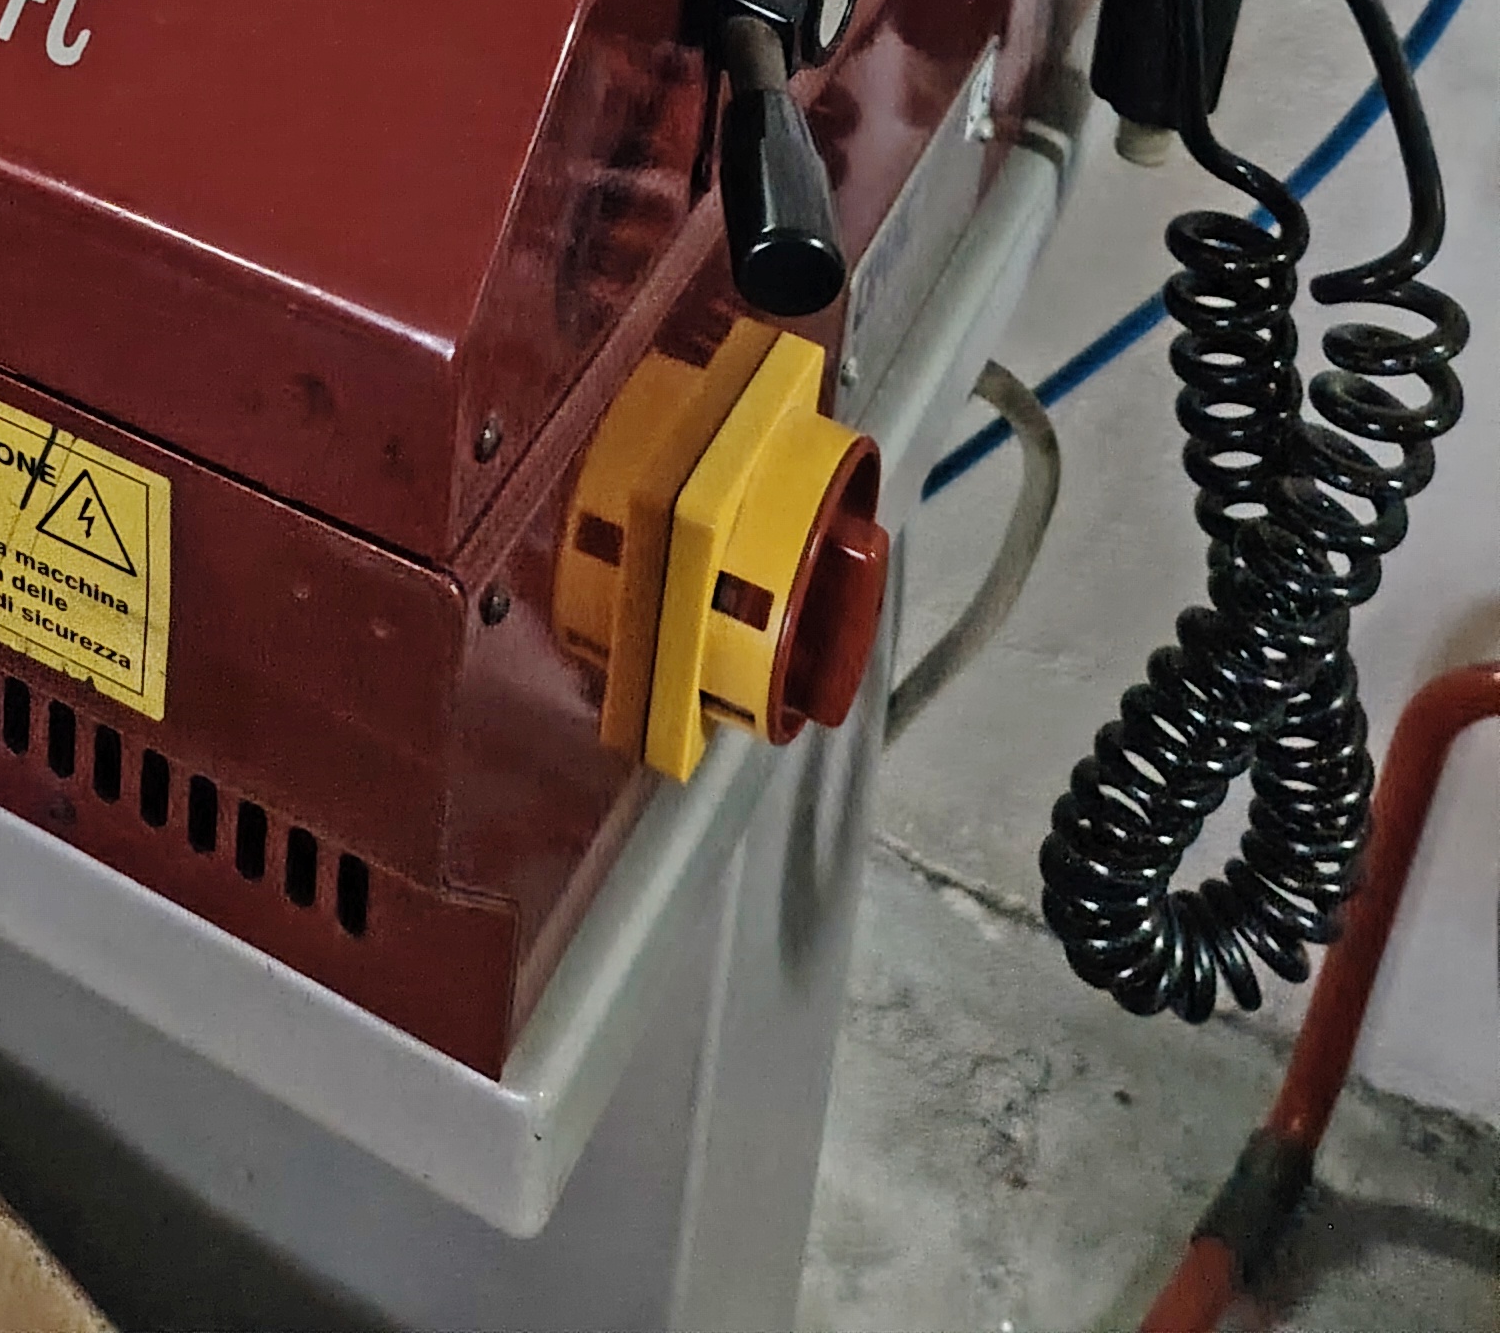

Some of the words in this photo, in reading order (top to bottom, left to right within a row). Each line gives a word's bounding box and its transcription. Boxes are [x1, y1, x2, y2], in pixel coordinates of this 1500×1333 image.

[11, 570, 69, 613] delle
[15, 549, 130, 615] macchina
[21, 605, 132, 671] sicurezza
